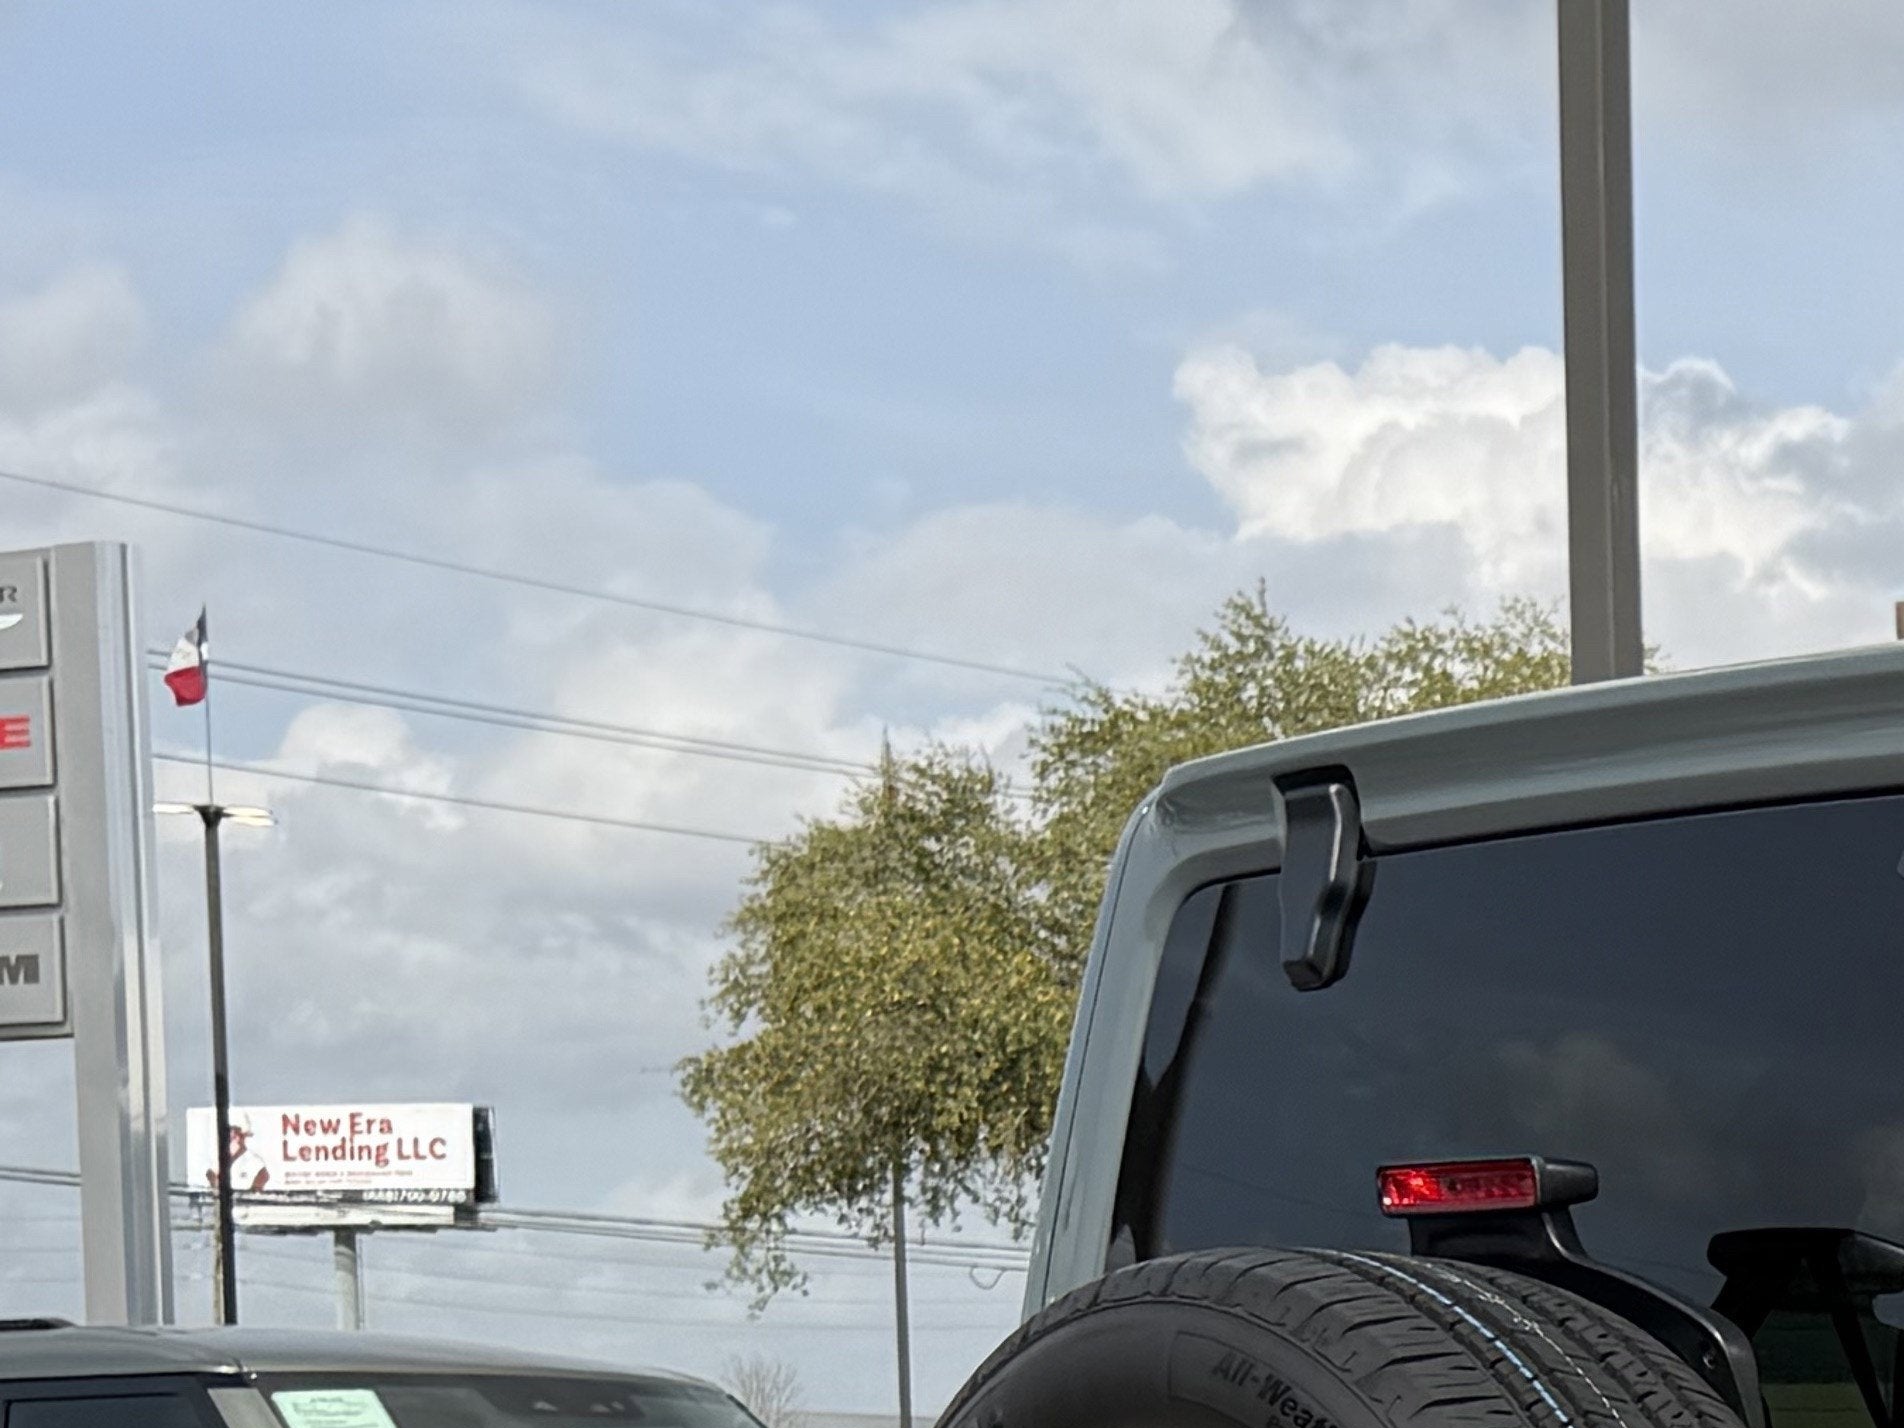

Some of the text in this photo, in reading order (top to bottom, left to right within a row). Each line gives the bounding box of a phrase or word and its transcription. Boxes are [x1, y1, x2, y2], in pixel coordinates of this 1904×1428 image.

[282, 1112, 394, 1136] New Era
[282, 1136, 448, 1168] Lending LLC
